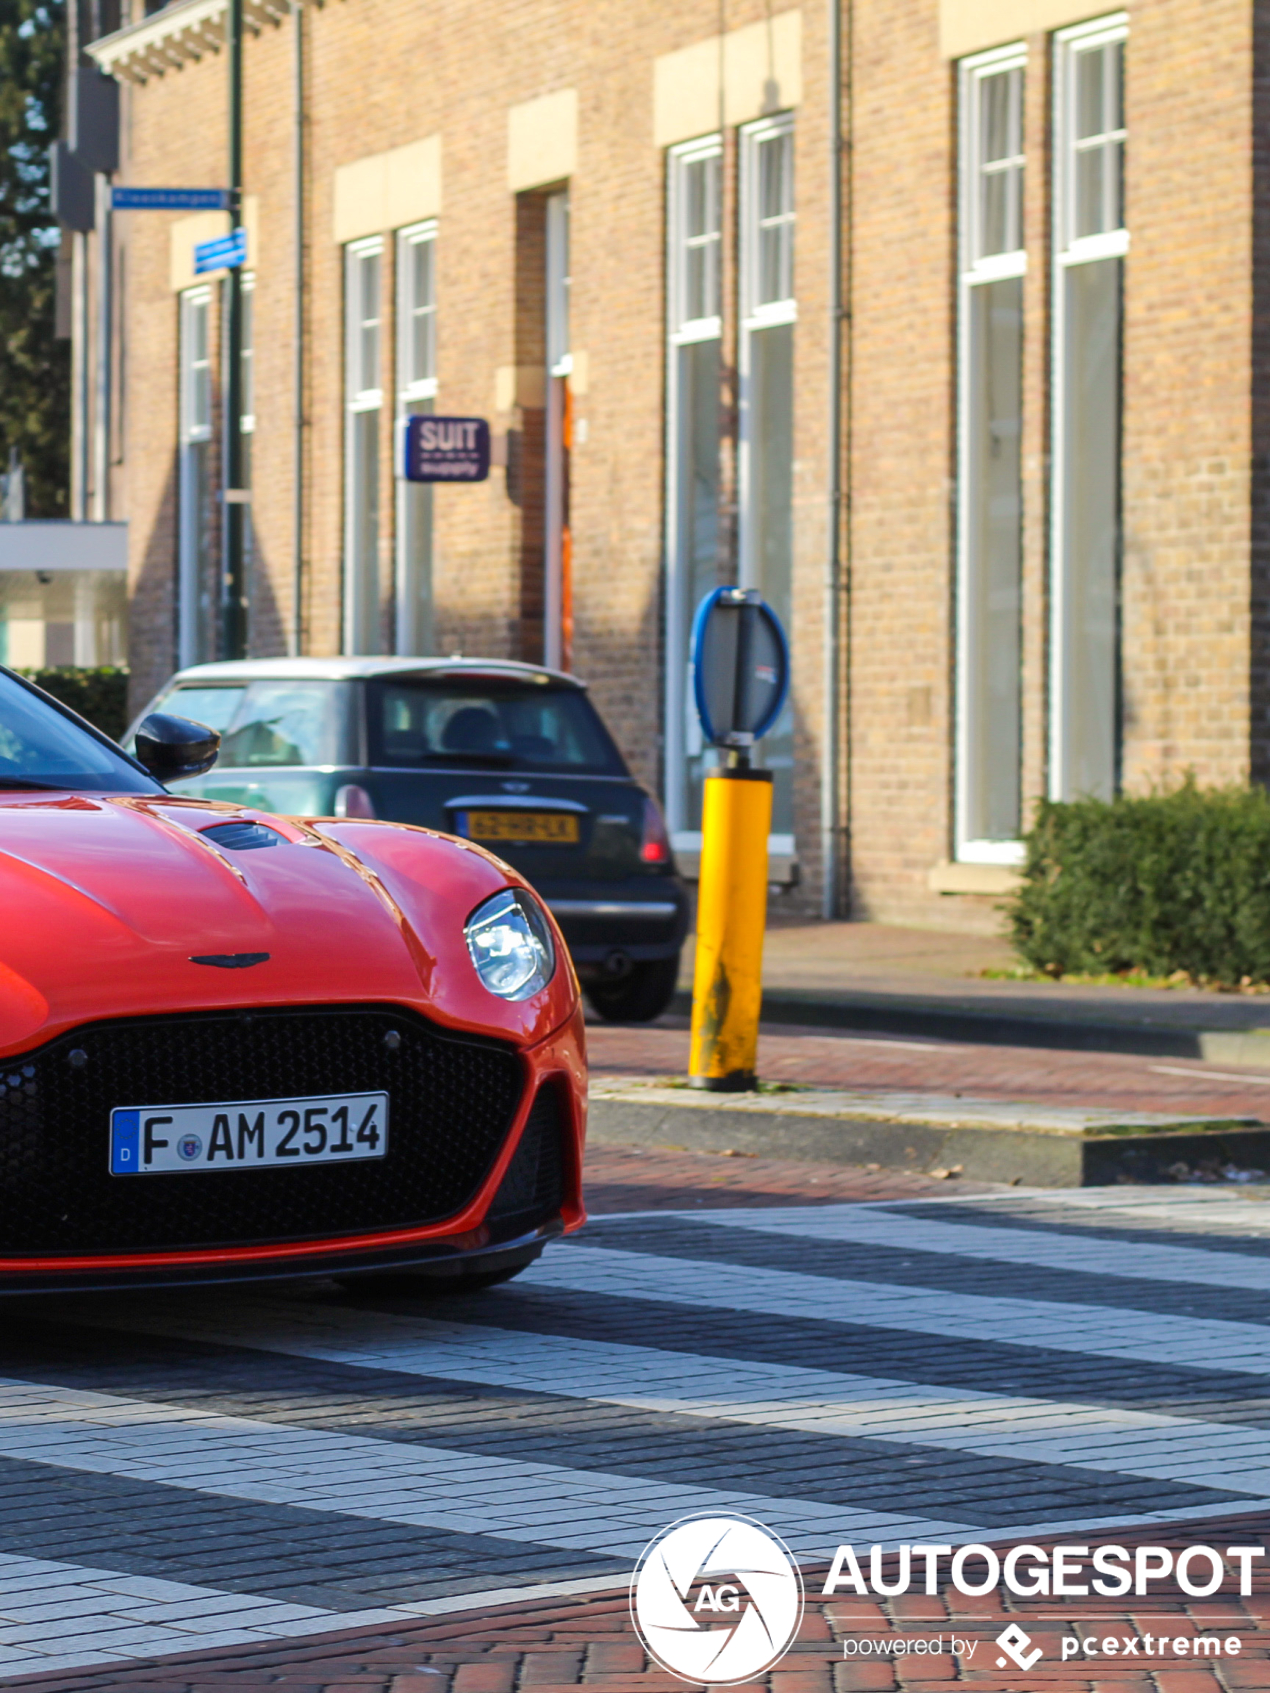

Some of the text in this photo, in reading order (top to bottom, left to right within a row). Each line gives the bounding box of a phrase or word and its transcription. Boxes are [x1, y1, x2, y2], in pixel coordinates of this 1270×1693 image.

[420, 421, 479, 450] SUIT
[144, 1104, 380, 1165] F AM 2514
[120, 1148, 130, 1162] D
